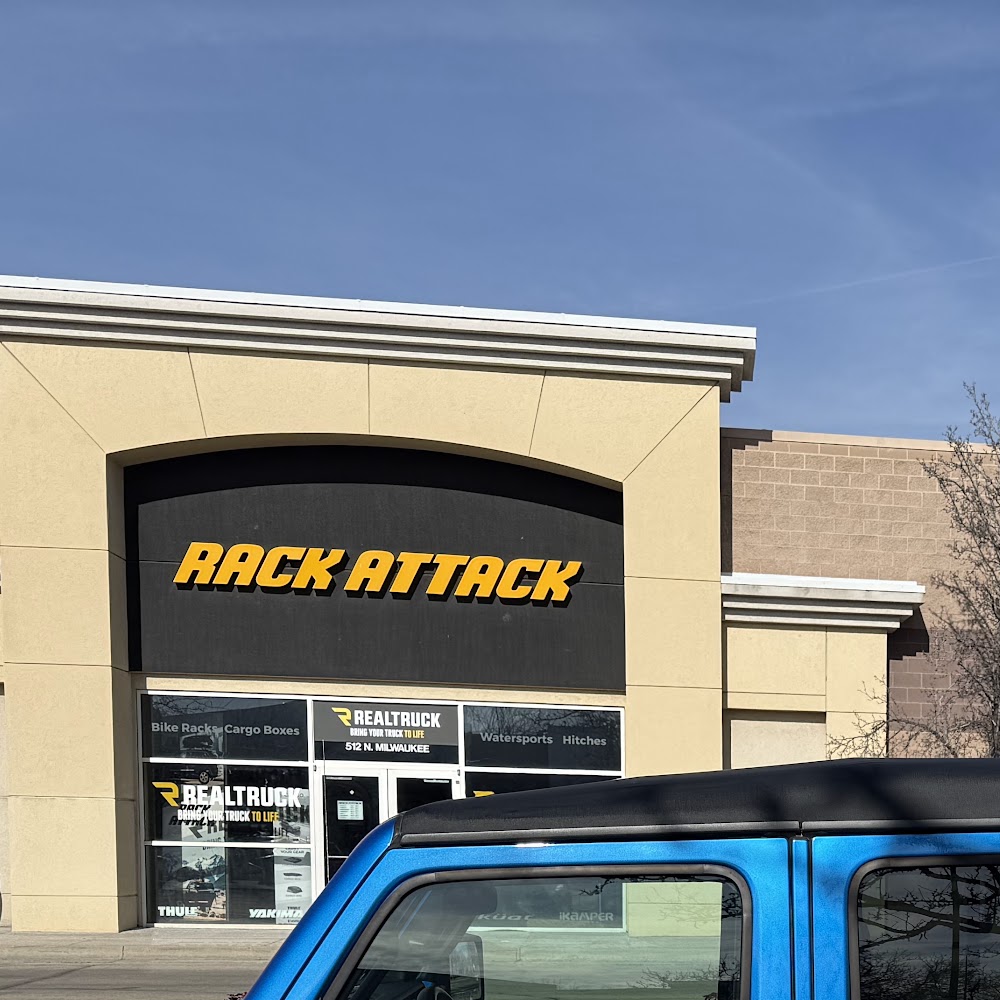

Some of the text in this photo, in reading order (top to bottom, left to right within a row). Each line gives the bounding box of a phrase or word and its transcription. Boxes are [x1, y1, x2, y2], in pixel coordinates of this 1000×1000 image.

[173, 541, 582, 606] RACK ATTACK
[354, 709, 441, 728] REALTRUCK
[151, 722, 300, 736] Bike Racks Cargo Boxes
[350, 728, 425, 739] BRING YOUR TRUCK TO LIFE
[480, 732, 607, 746] Watersports Hitches
[345, 742, 430, 753] 512 N. MILWAUKEE
[181, 784, 302, 808] REALTRUCK
[177, 810, 279, 822] BRING YOUR TRUCK TO LIFE
[157, 906, 198, 917] THULE
[248, 908, 304, 919] YAKIMA
